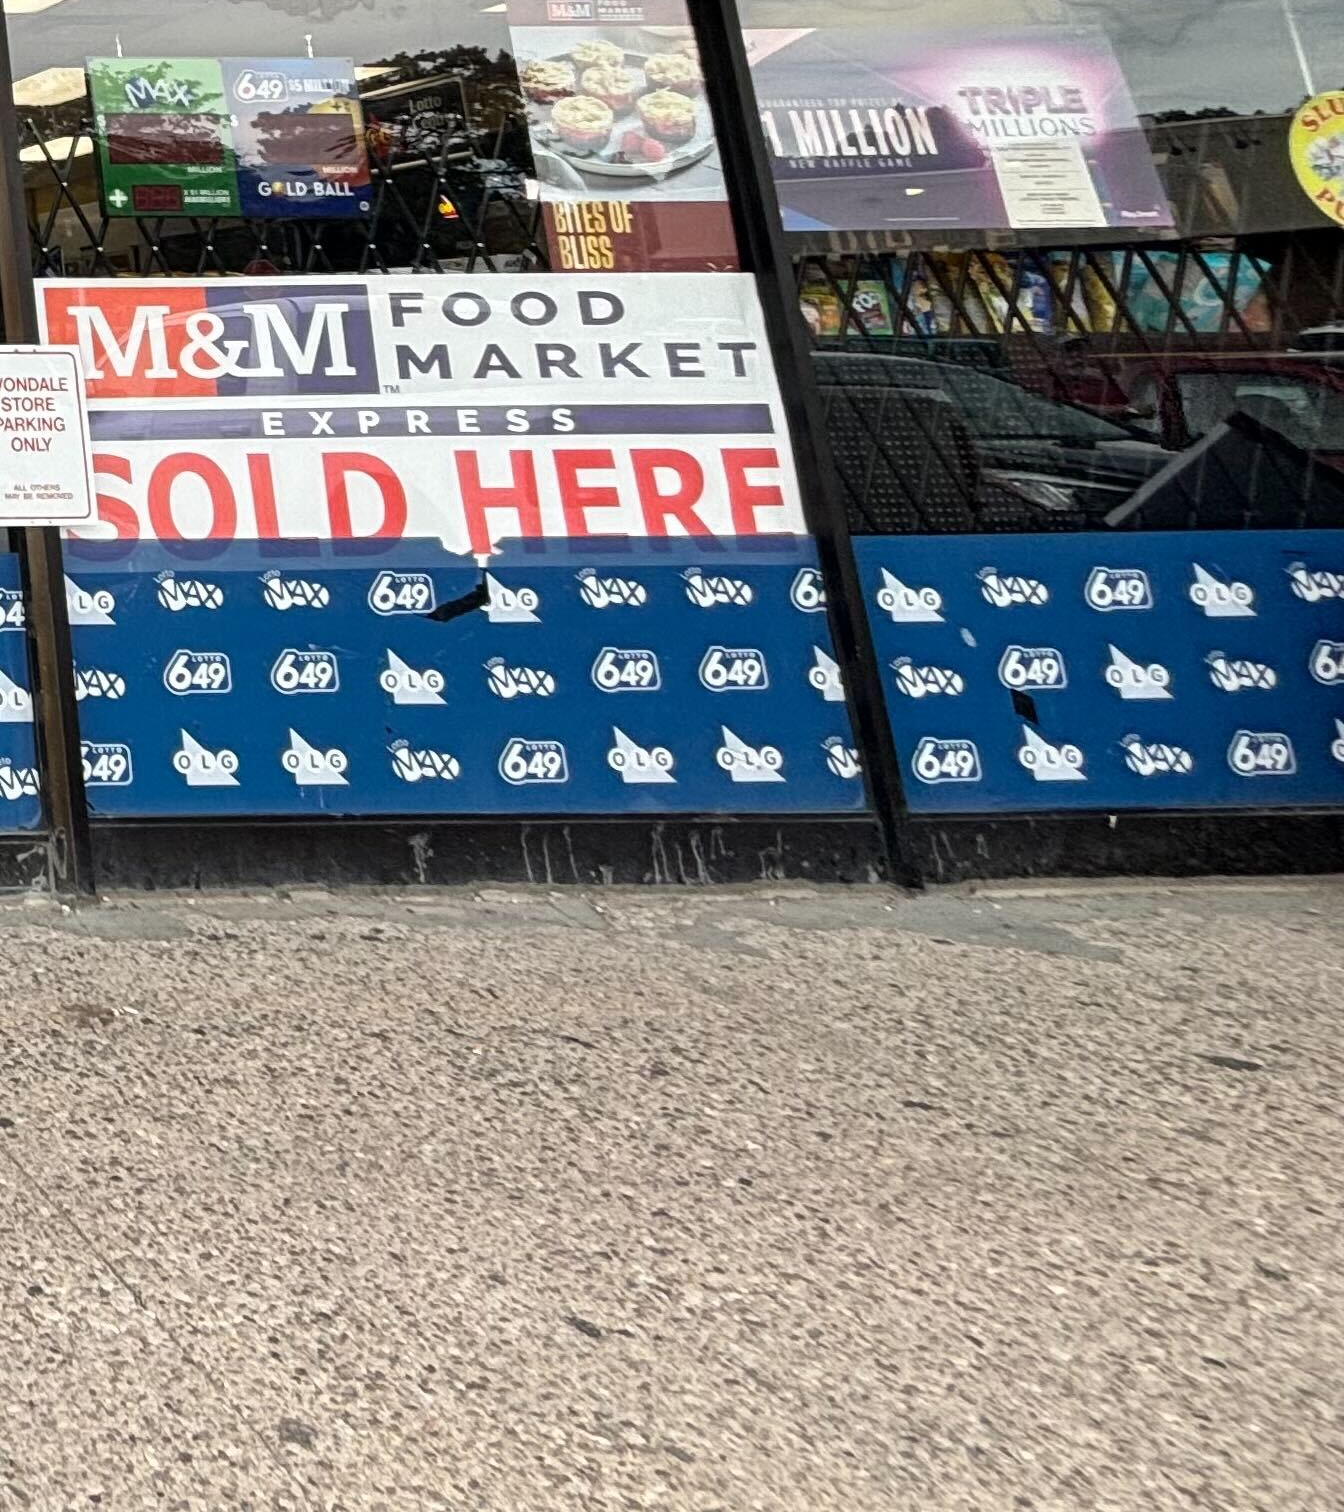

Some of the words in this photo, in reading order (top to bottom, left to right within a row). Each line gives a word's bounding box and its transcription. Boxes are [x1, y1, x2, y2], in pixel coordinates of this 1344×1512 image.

[551, 3, 592, 18] M&M
[124, 77, 194, 109] MAX
[238, 73, 284, 101] 649
[408, 96, 443, 114] Lotto
[958, 86, 1089, 116] TRIPLE
[789, 104, 940, 157] MILLION
[967, 116, 1097, 138] MILLIONS
[315, 181, 354, 196] BALL
[553, 201, 606, 233] BITES
[608, 201, 634, 233] OF
[558, 236, 614, 270] BLISS
[389, 291, 626, 326] FOOD
[66, 303, 358, 380] M&M
[396, 343, 758, 380] MARKET
[1, 397, 56, 412] STORE
[263, 408, 578, 436] EXPRESS
[11, 437, 53, 453] ONLY
[67, 451, 406, 562] SOLD
[452, 447, 796, 556] HERE
